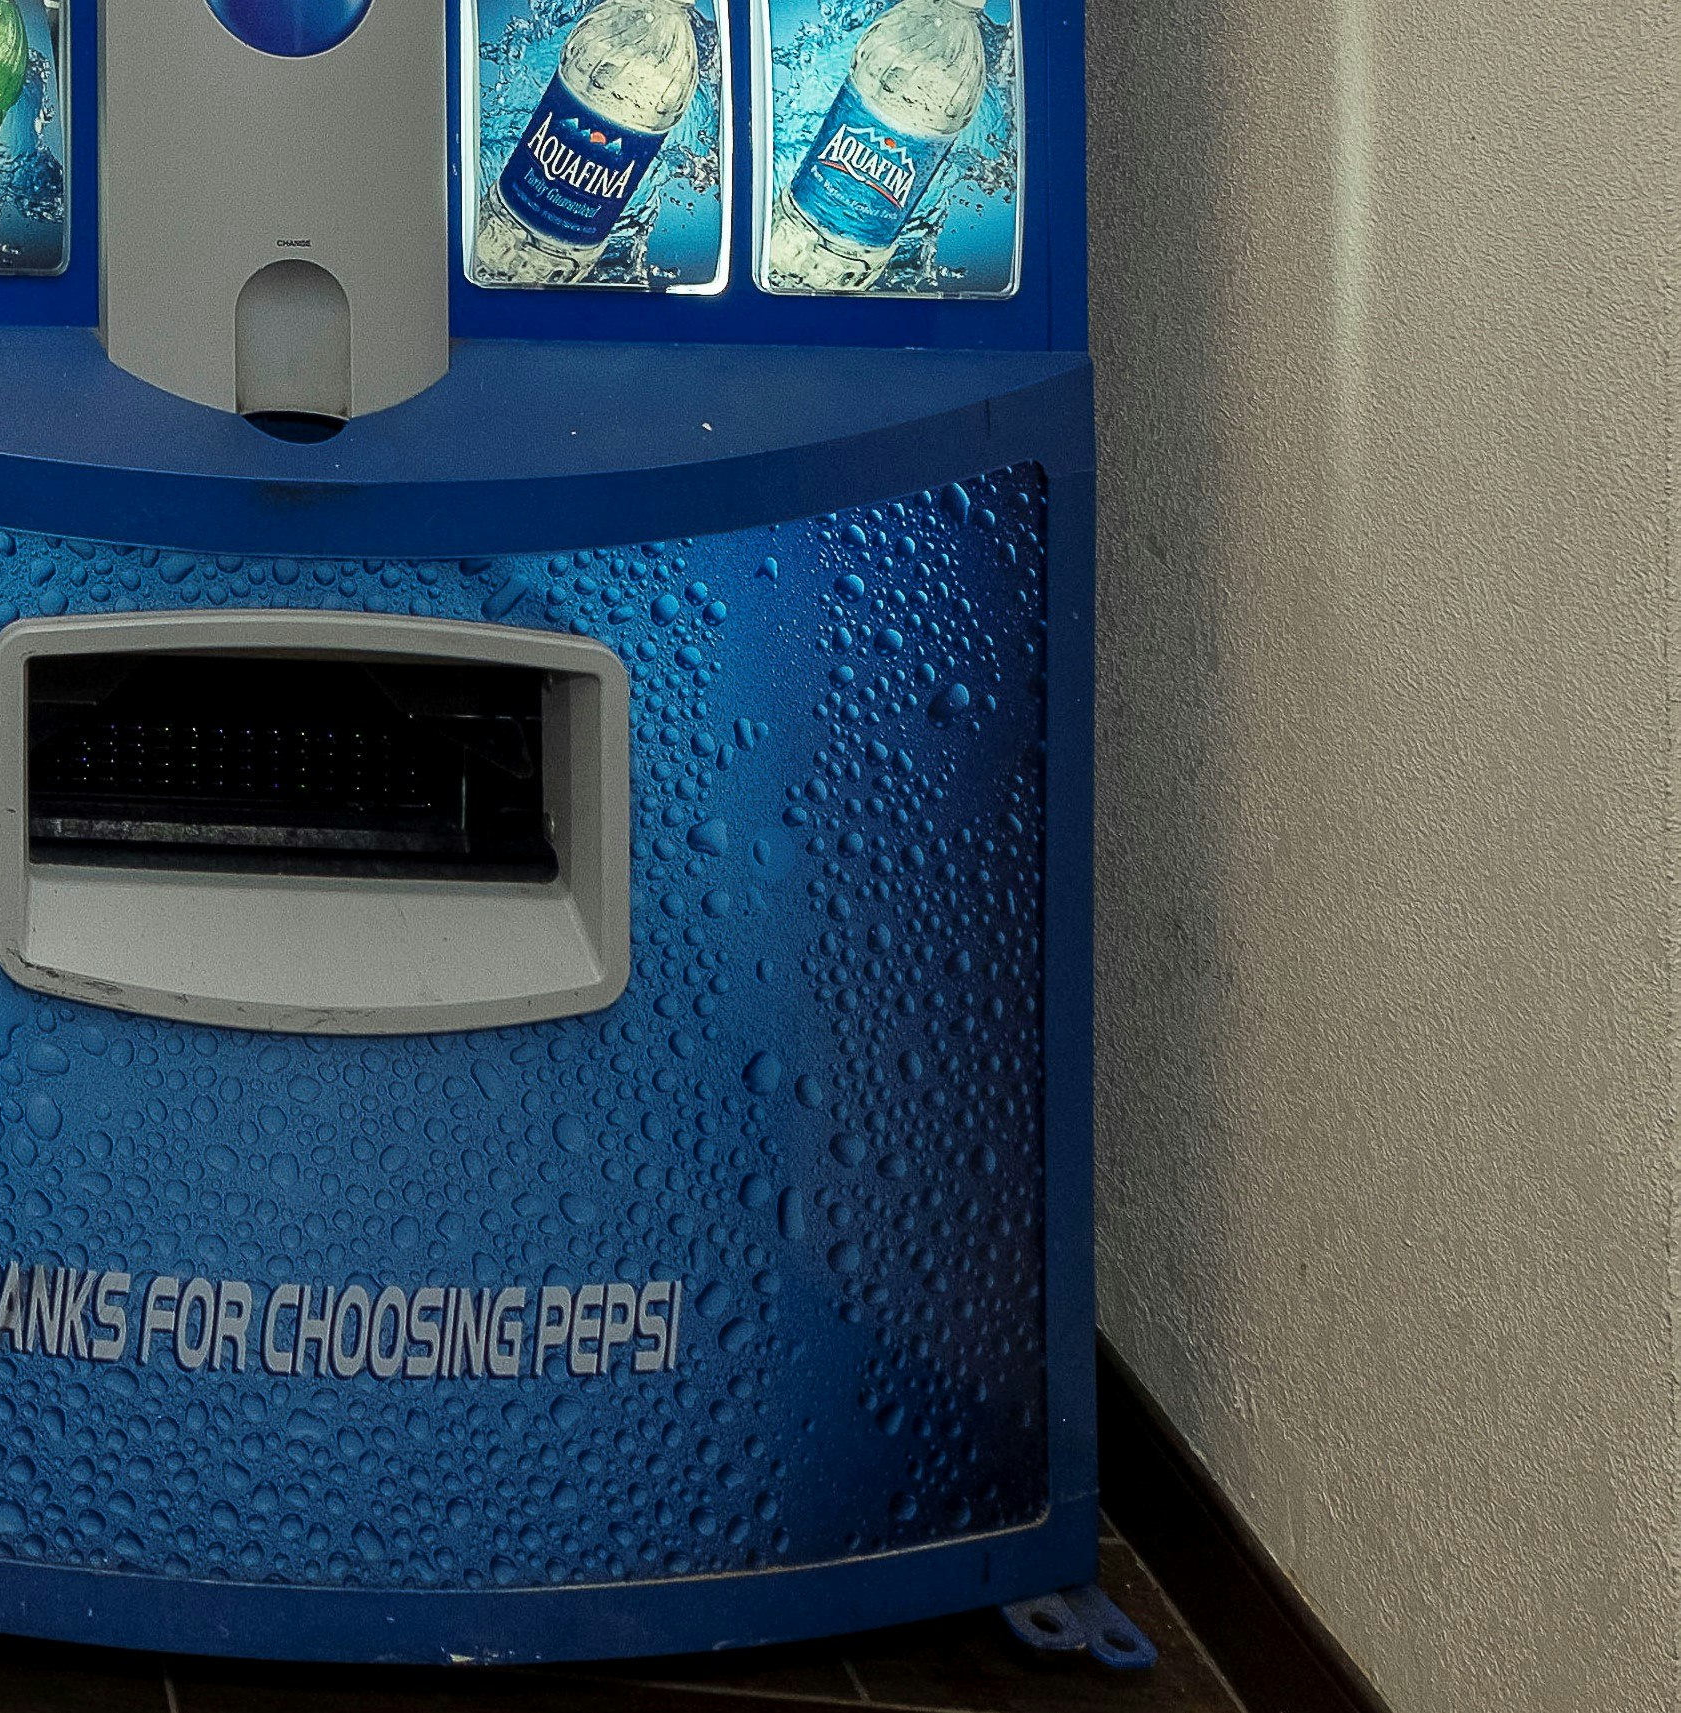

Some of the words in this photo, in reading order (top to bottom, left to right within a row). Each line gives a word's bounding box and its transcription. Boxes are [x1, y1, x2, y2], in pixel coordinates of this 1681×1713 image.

[527, 111, 636, 199] AQUAFINA
[817, 123, 916, 208] AQUAFINA
[276, 238, 312, 248] CHANGE
[138, 1274, 253, 1373] FOR
[262, 1282, 528, 1380] CHOOSING
[532, 1279, 685, 1378] PEPSI
